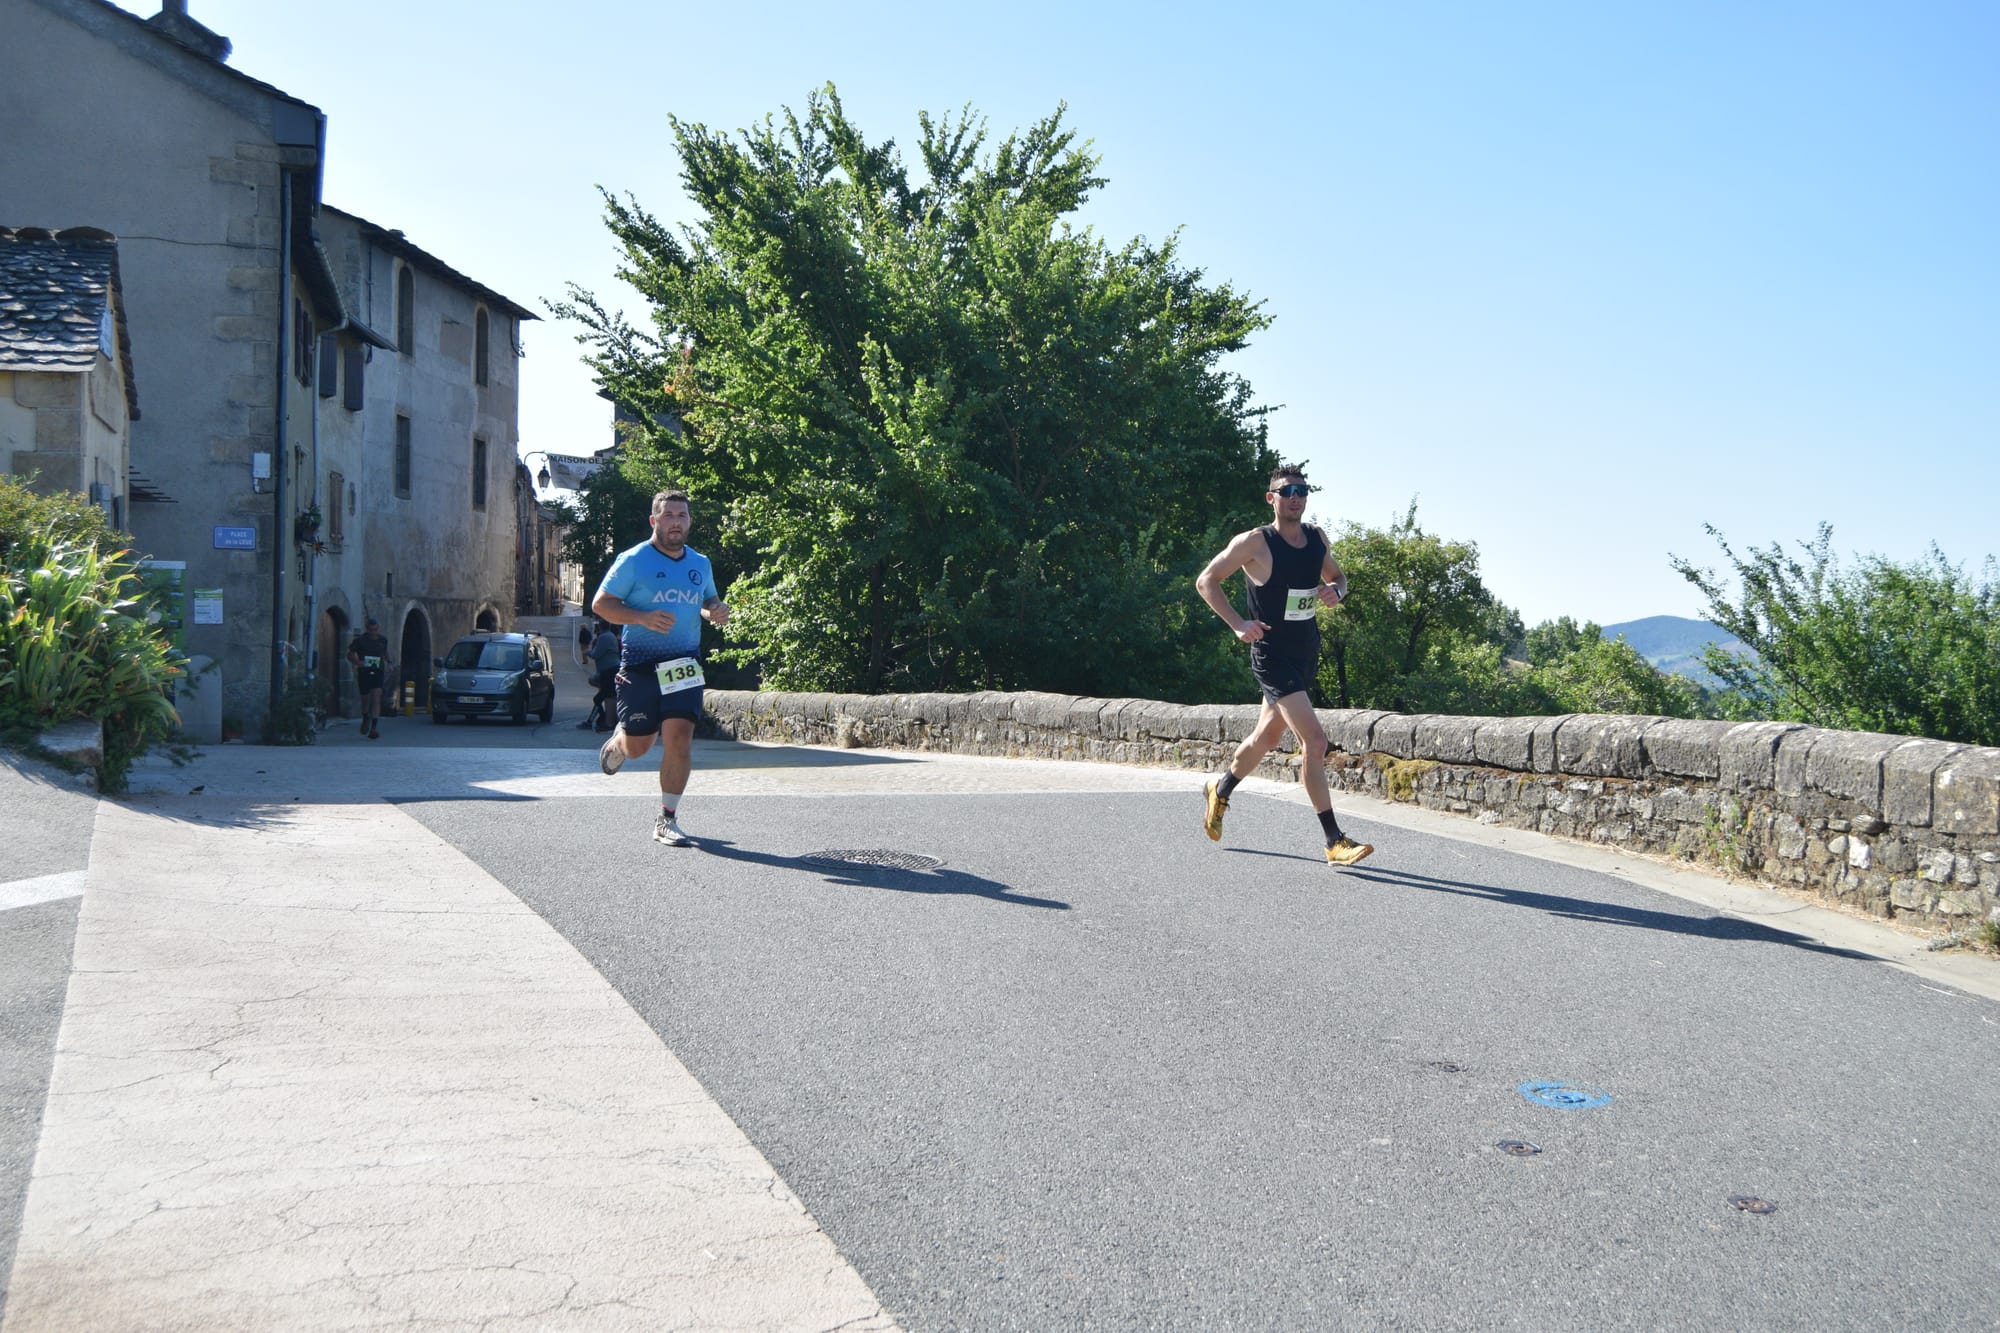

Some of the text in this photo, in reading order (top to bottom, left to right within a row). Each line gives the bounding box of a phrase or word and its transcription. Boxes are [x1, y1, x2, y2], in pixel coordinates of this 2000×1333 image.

[550, 455, 586, 464] MAISON
[588, 457, 601, 465] DE
[652, 589, 699, 604] ACNA
[1298, 597, 1314, 610] 82
[665, 665, 696, 682] 138
